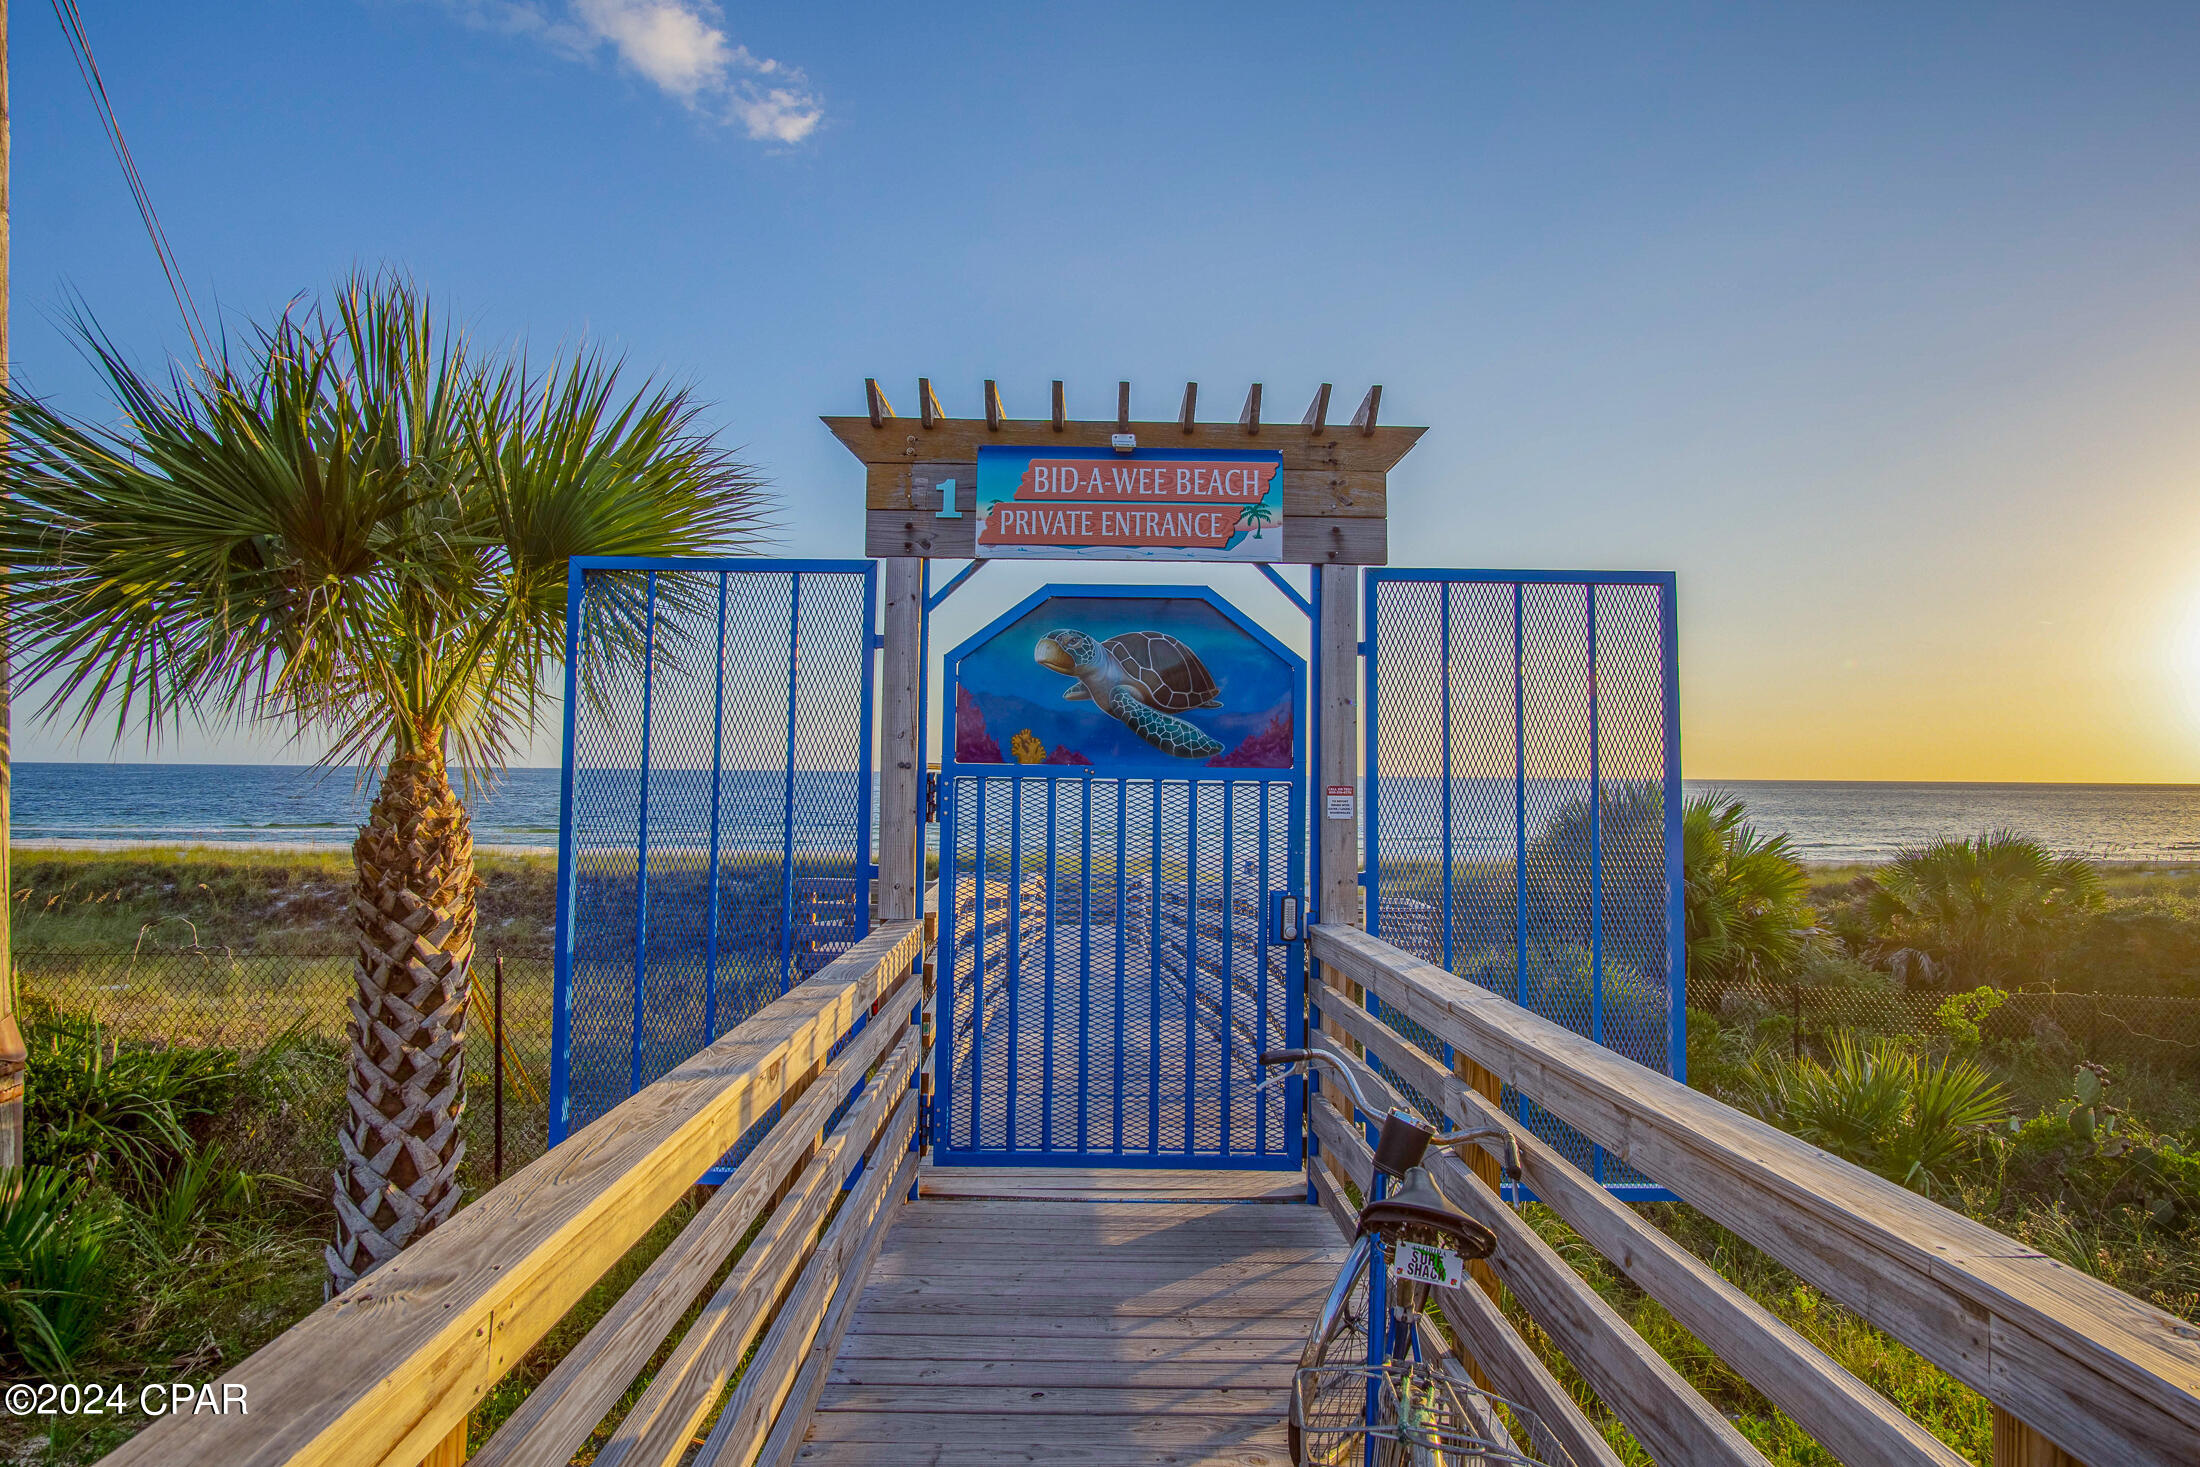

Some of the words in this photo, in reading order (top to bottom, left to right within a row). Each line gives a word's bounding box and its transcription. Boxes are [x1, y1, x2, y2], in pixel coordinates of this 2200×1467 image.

[1034, 466, 1167, 495] BID-A-WEE
[1176, 468, 1259, 497] BEACH
[935, 478, 963, 519] 1
[1000, 509, 1093, 537] PRIVATE
[1102, 511, 1223, 539] ENTRANCE
[1407, 1262, 1446, 1281] SHACK
[1411, 1250, 1444, 1267] SURF
